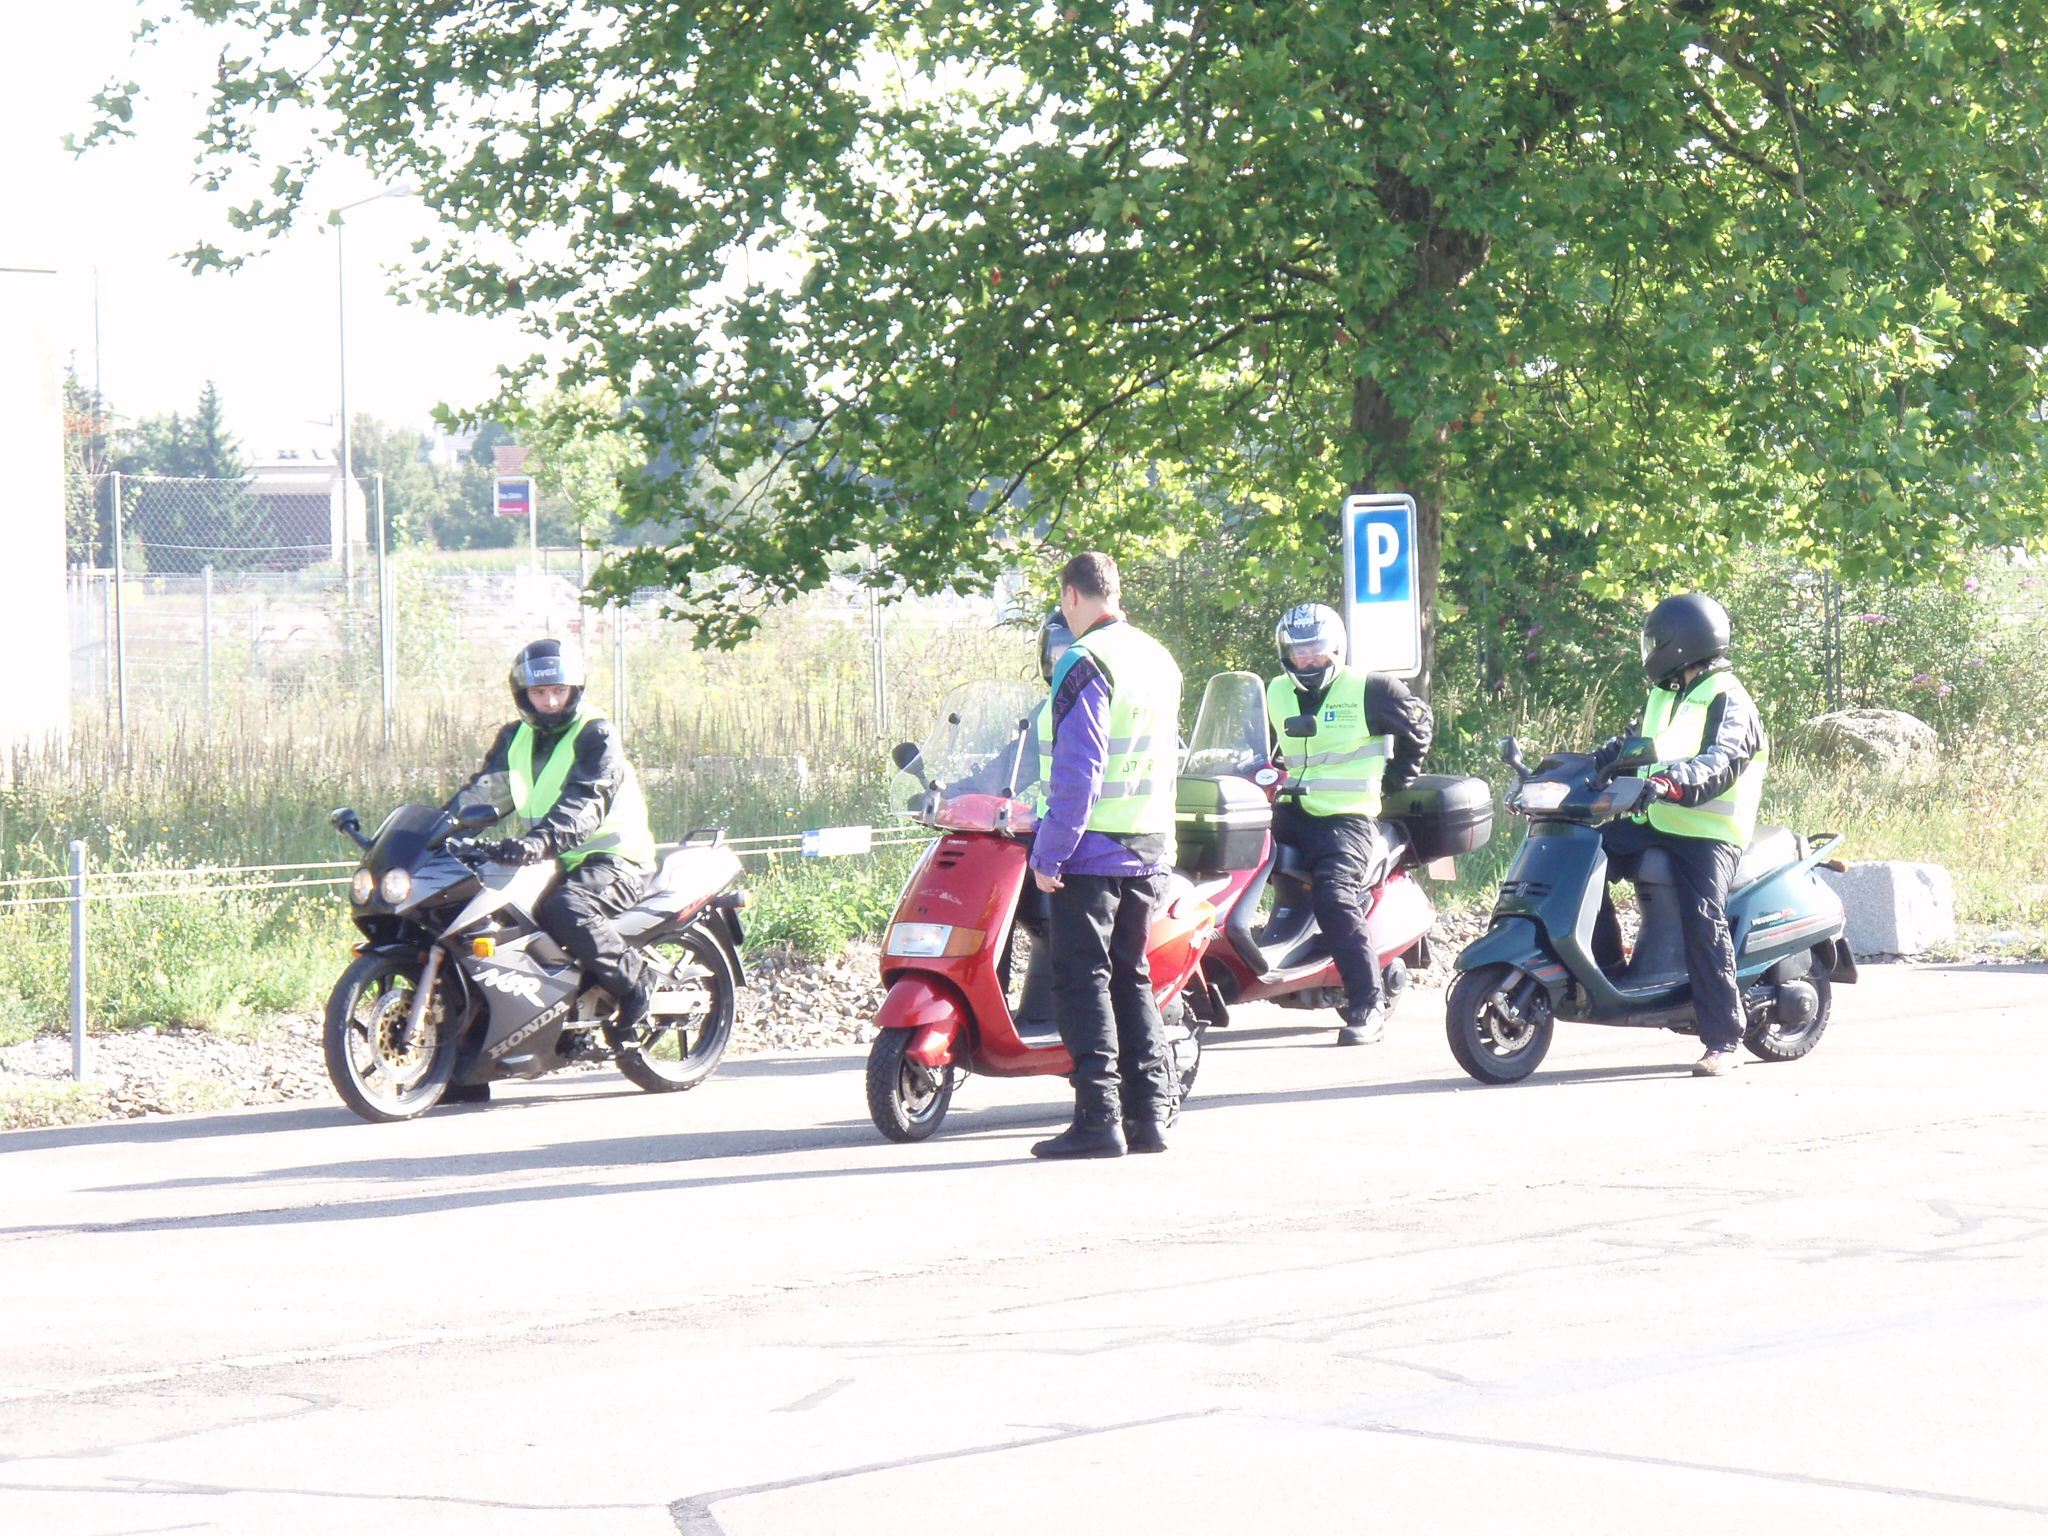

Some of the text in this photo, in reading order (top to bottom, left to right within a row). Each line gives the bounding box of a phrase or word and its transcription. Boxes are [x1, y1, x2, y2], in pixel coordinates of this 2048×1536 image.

[1367, 522, 1399, 595] P
[1326, 712, 1333, 721] L
[488, 1000, 571, 1060] HONDA
